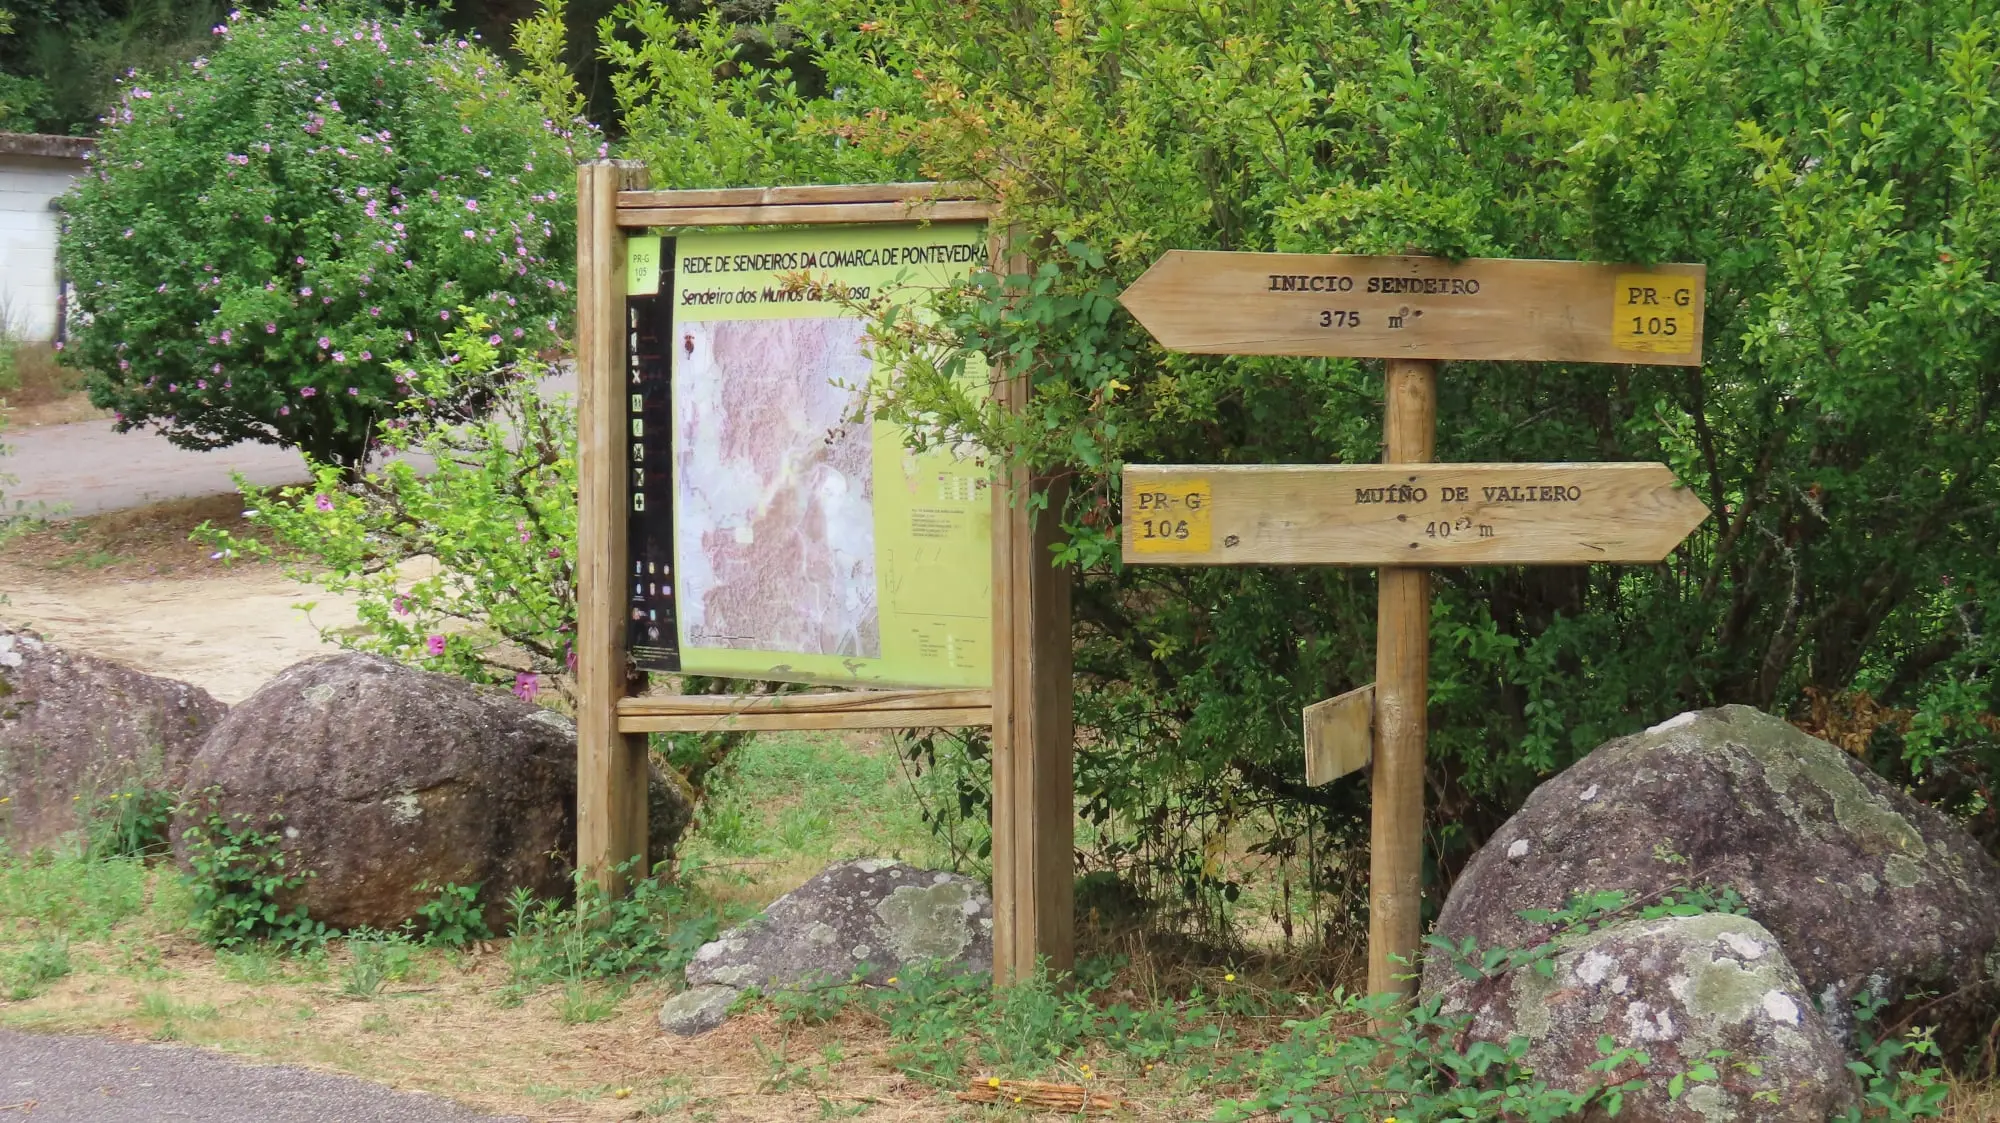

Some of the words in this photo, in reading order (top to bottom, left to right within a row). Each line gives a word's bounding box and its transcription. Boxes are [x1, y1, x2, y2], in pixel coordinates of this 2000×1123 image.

[683, 257, 713, 273] REDE
[715, 255, 732, 272] DE
[733, 252, 798, 272] SENDEIROS
[801, 251, 817, 268] DA
[819, 249, 879, 268] COMARCA
[882, 248, 899, 265] DE
[902, 244, 989, 264] PONTEVEDRA
[635, 267, 647, 277] 105
[1268, 275, 1354, 292] INICIO
[1367, 276, 1480, 295] SENDEIRO
[681, 287, 733, 306] Sendeiro
[735, 286, 758, 304] dos
[1319, 310, 1361, 328] 375
[1632, 316, 1677, 335] 105
[1138, 493, 1201, 510] PR-G
[1355, 484, 1428, 503] MUÍÑO
[1441, 487, 1469, 502] DE
[1482, 485, 1582, 502] VALIERO
[1479, 523, 1494, 537] m
